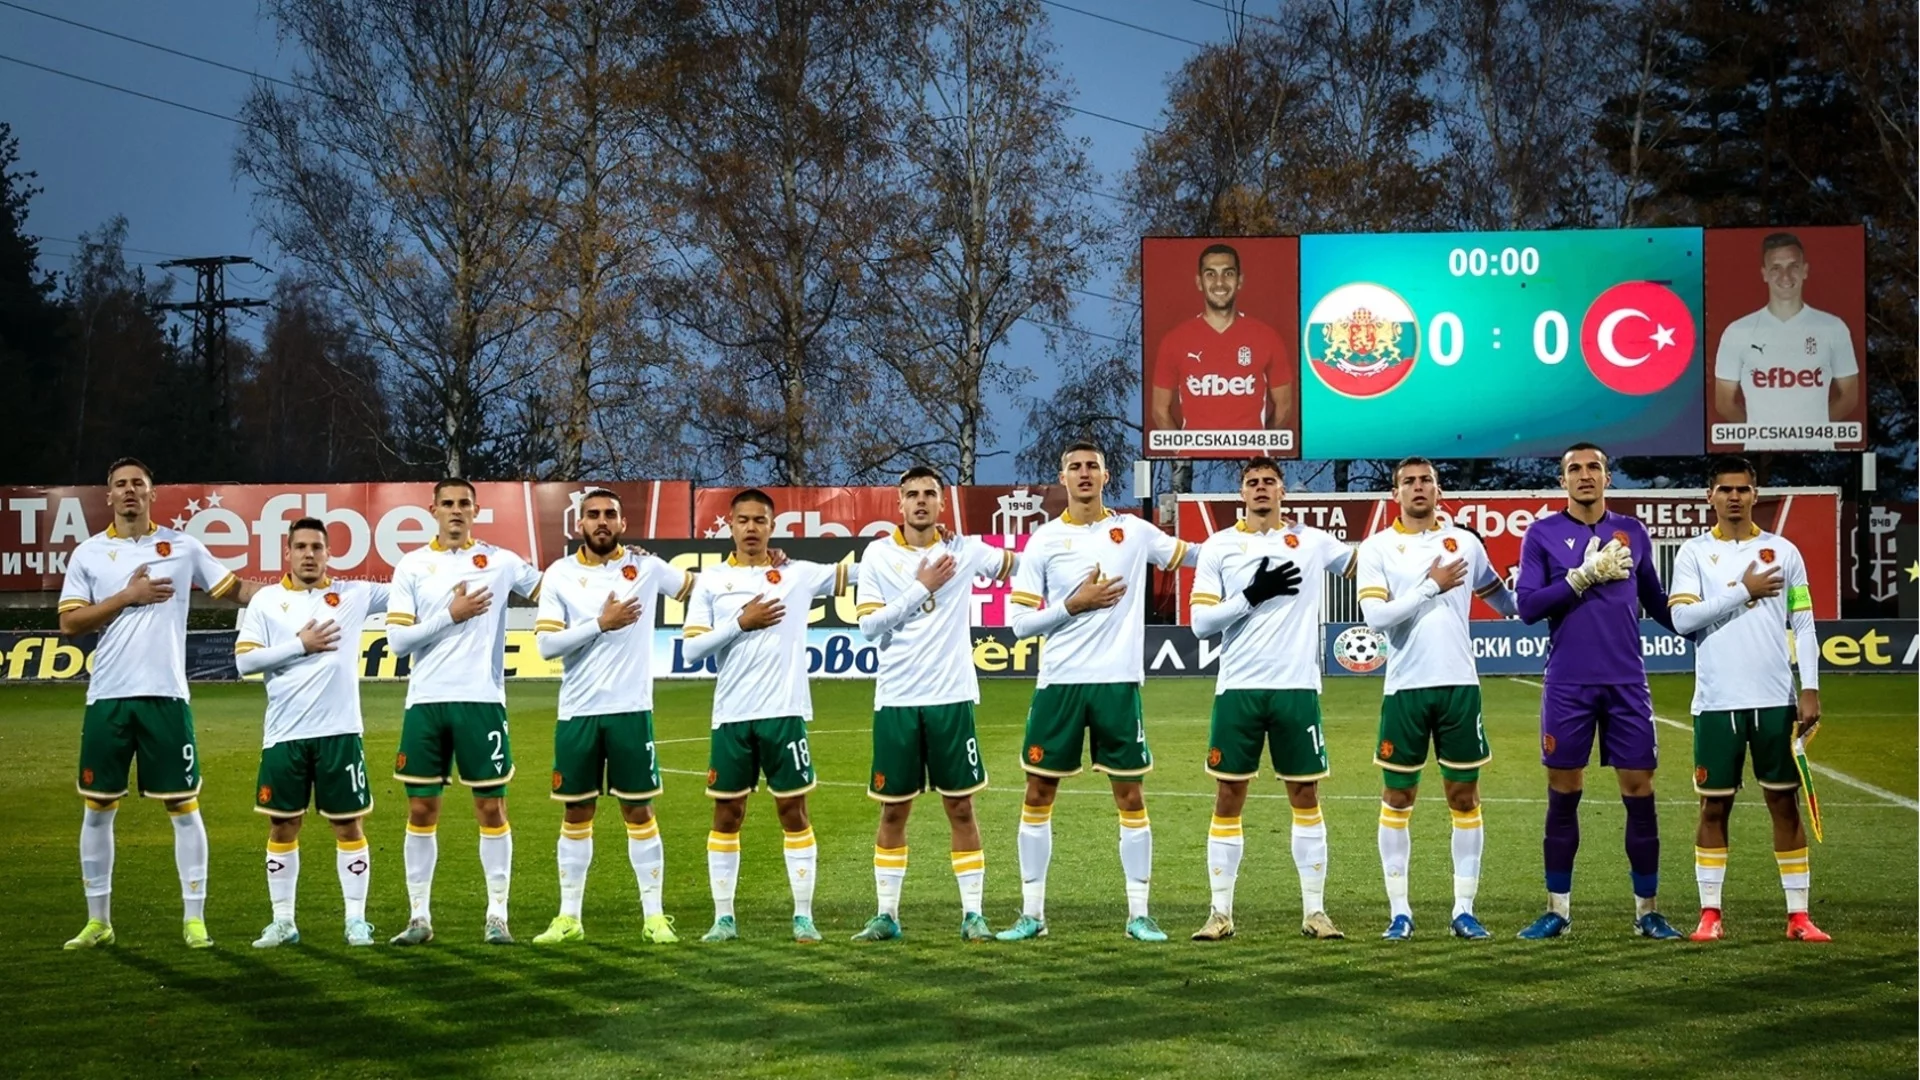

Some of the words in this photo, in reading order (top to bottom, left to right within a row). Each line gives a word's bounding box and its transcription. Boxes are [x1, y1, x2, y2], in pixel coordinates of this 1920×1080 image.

[1449, 247, 1539, 276] 00:00
[1428, 311, 1465, 366] 0
[1533, 309, 1569, 365] 0
[1187, 374, 1256, 396] efbet
[1752, 366, 1824, 388] efbet
[1153, 434, 1290, 447] SHOP.CSKA1948.BG
[1716, 426, 1858, 440] SHOP.CSKA1948.BG
[0, 497, 91, 544] ТА
[1008, 502, 1033, 511] 1948
[1236, 506, 1347, 527] ТТА
[1636, 504, 1711, 524] ЧЕСТ
[186, 493, 493, 571] efbe
[1648, 526, 1686, 538] РЕДИ
[1871, 518, 1891, 527] 948
[1473, 637, 1511, 658] СКИ
[1640, 635, 1686, 656] ЪЮЗ
[1818, 628, 1892, 666] et
[183, 743, 194, 772] 9
[487, 730, 505, 761] 2
[645, 741, 655, 770] 7
[786, 738, 811, 771] 18
[966, 737, 978, 766] 8
[345, 760, 366, 793] 16
